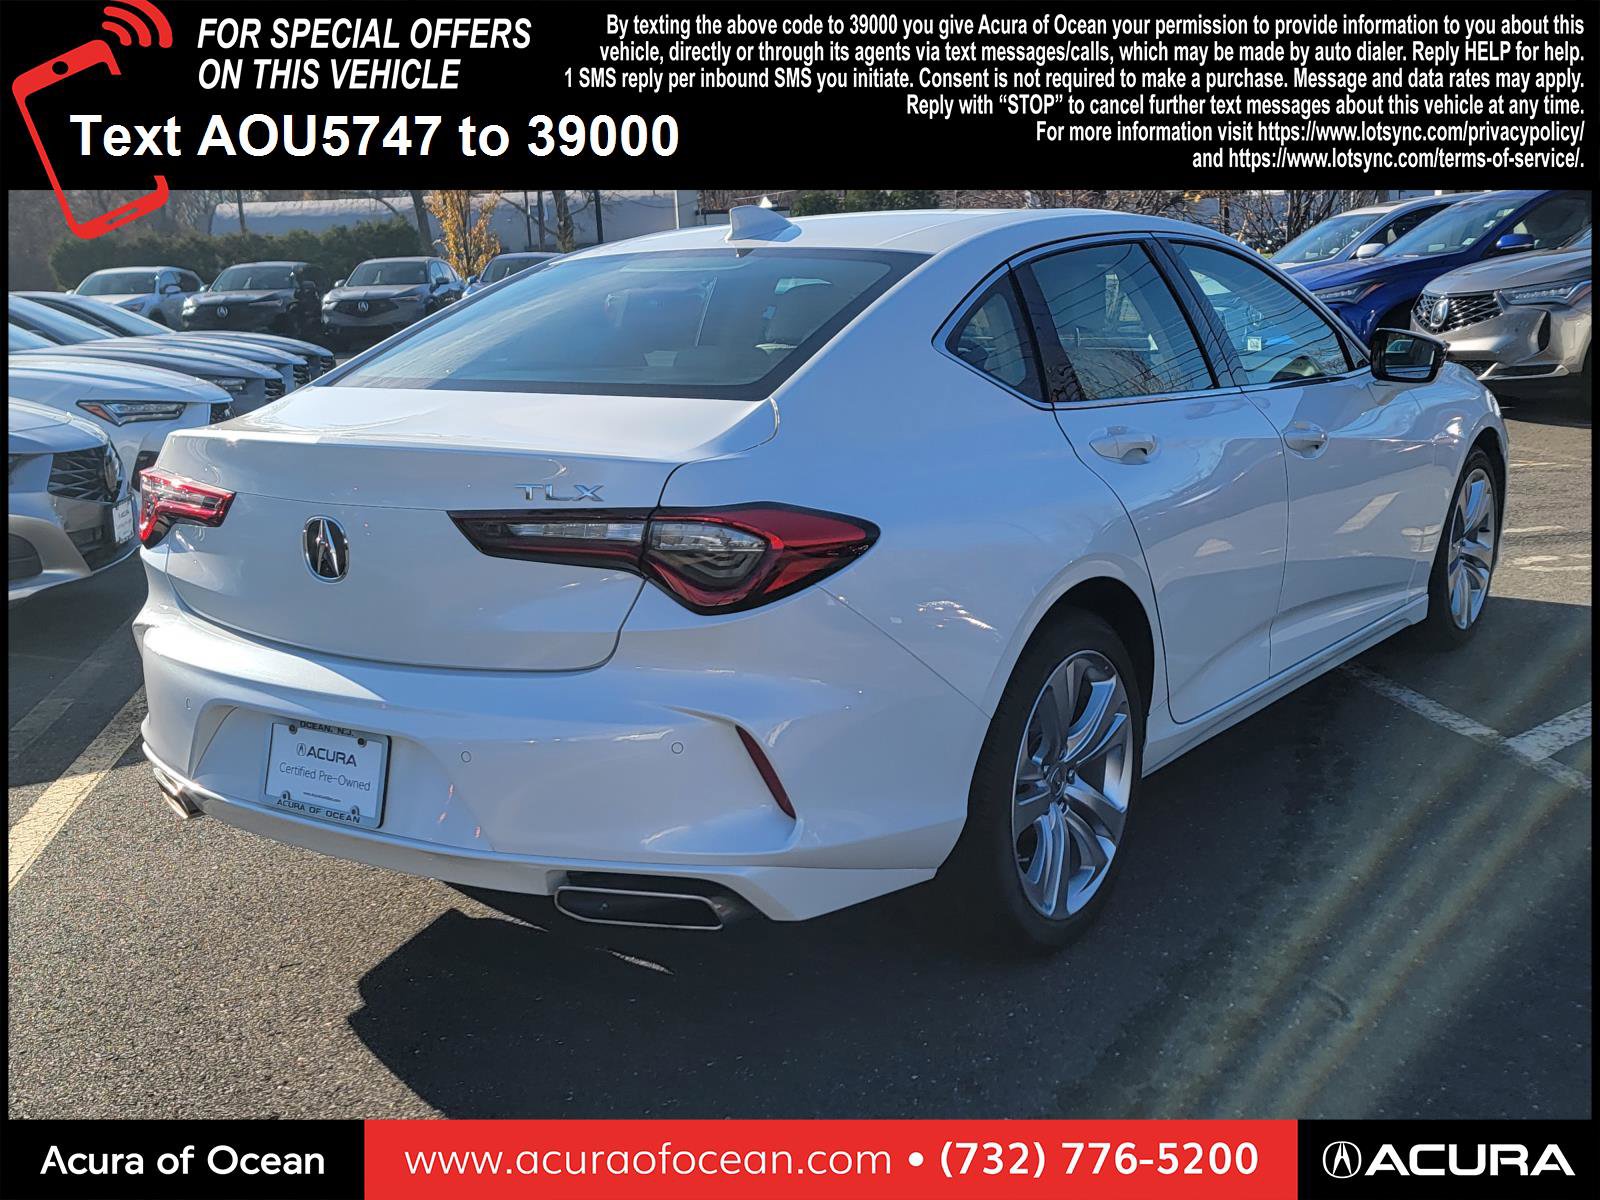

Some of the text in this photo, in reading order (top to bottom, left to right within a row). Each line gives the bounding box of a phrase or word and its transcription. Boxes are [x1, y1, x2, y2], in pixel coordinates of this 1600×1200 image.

[513, 484, 604, 502] TLX
[307, 746, 357, 767] ACURA
[279, 762, 371, 792] Certified Pre-Owned
[277, 799, 361, 823] ACURA OF OCEAN
